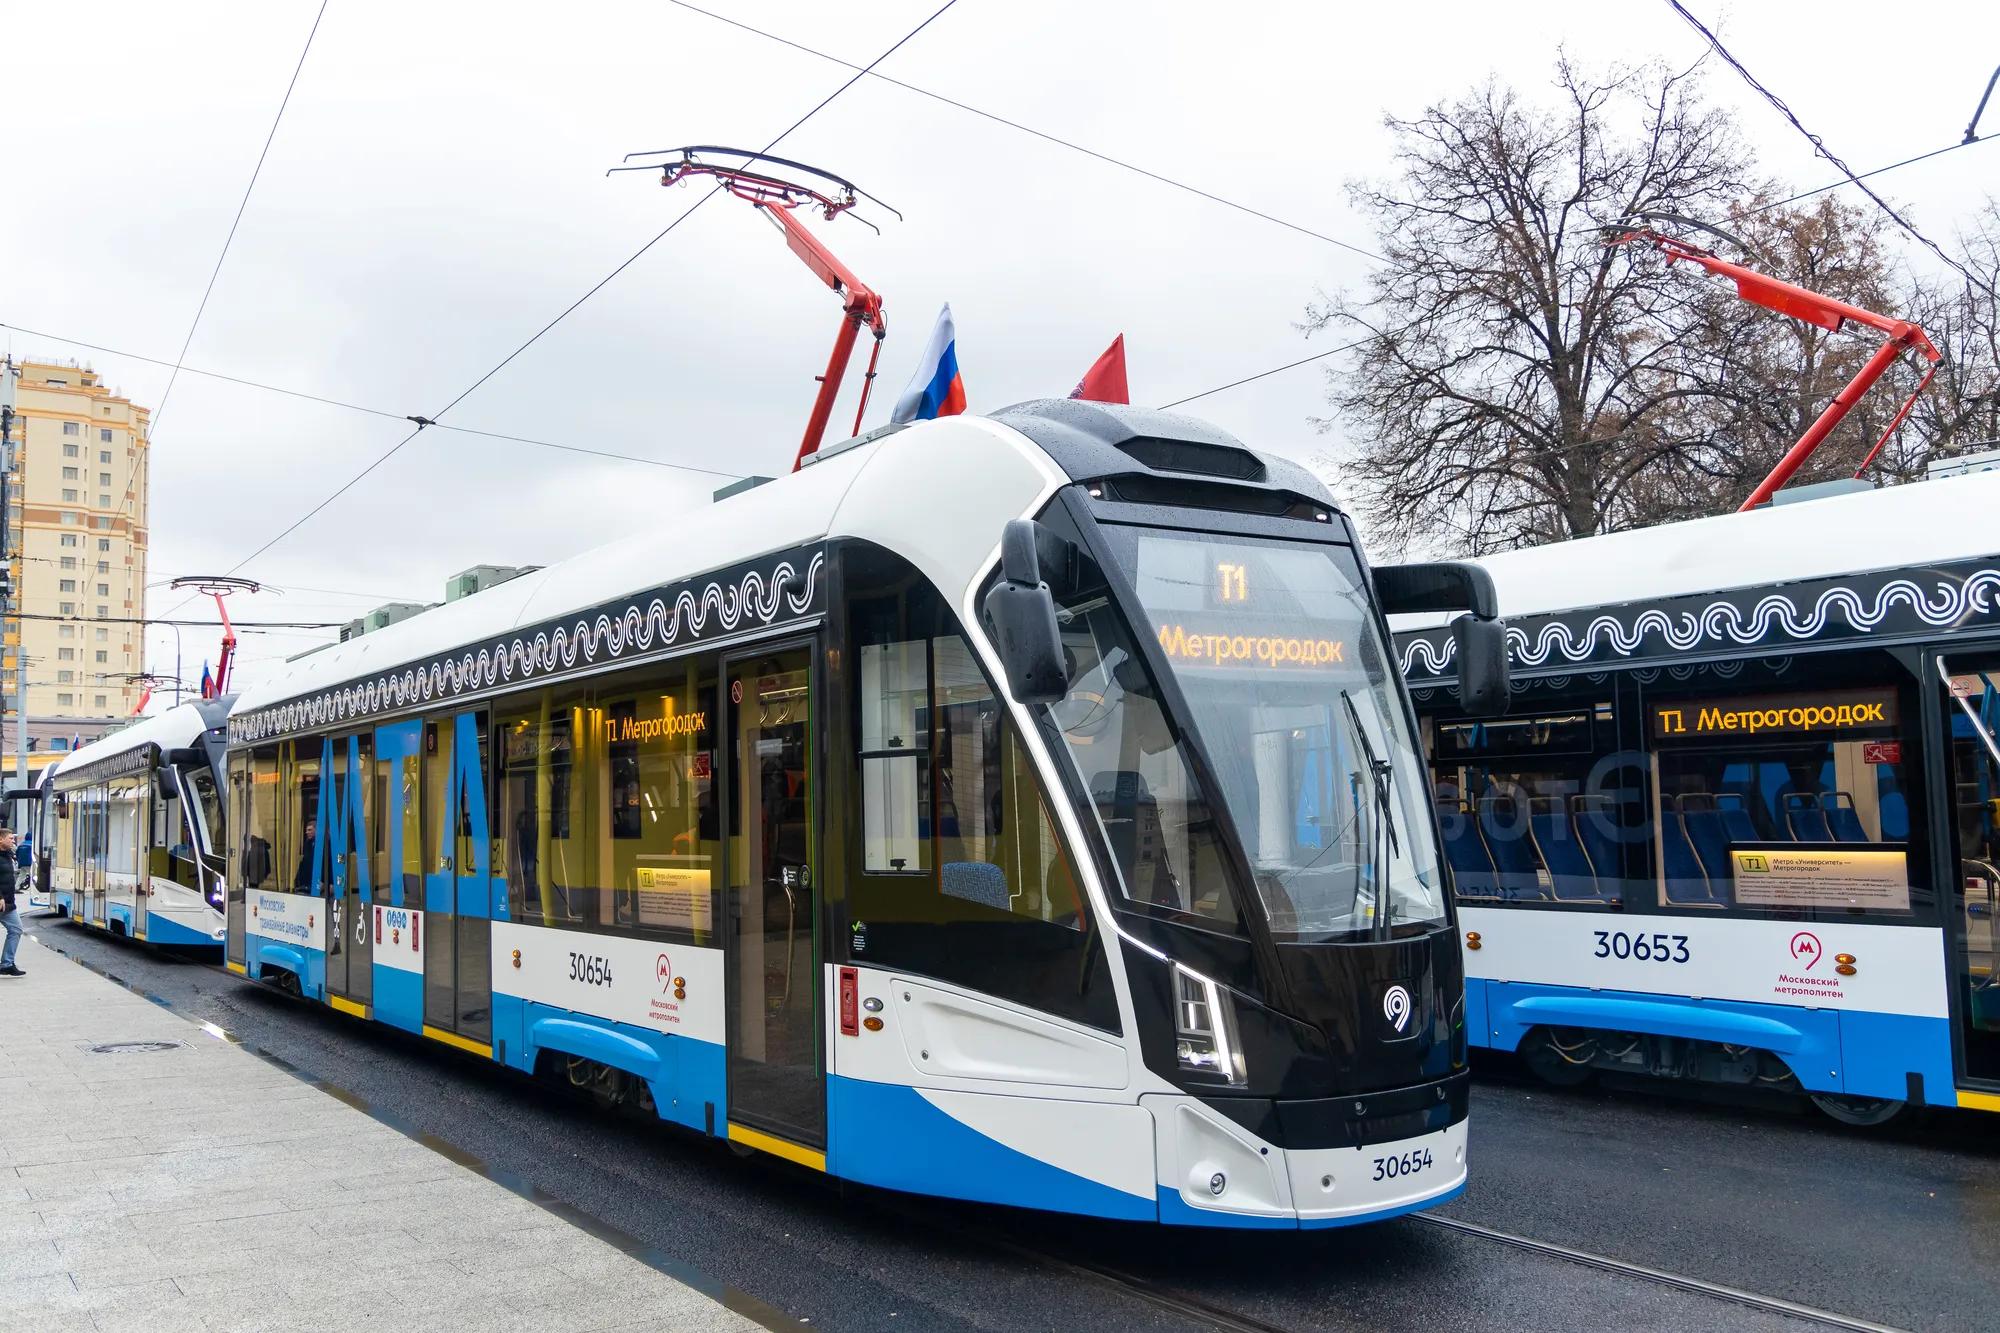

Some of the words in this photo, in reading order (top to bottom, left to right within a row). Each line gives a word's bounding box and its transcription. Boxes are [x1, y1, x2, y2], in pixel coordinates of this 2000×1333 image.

[1219, 564, 1246, 600] Т1
[1158, 624, 1344, 667] Метрогородок
[605, 719, 618, 742] Т1
[621, 712, 706, 743] Метрогородок
[1658, 710, 1686, 733] Т1
[1697, 703, 1885, 733] Метрогородок
[1746, 858, 1761, 869] Т1
[1594, 931, 1690, 963] 30653
[569, 952, 613, 989] 30654
[1779, 974, 1839, 987] Московский
[650, 999, 679, 1011] Московский
[1774, 986, 1844, 998] метрополитен
[1373, 1147, 1433, 1182] 30654
